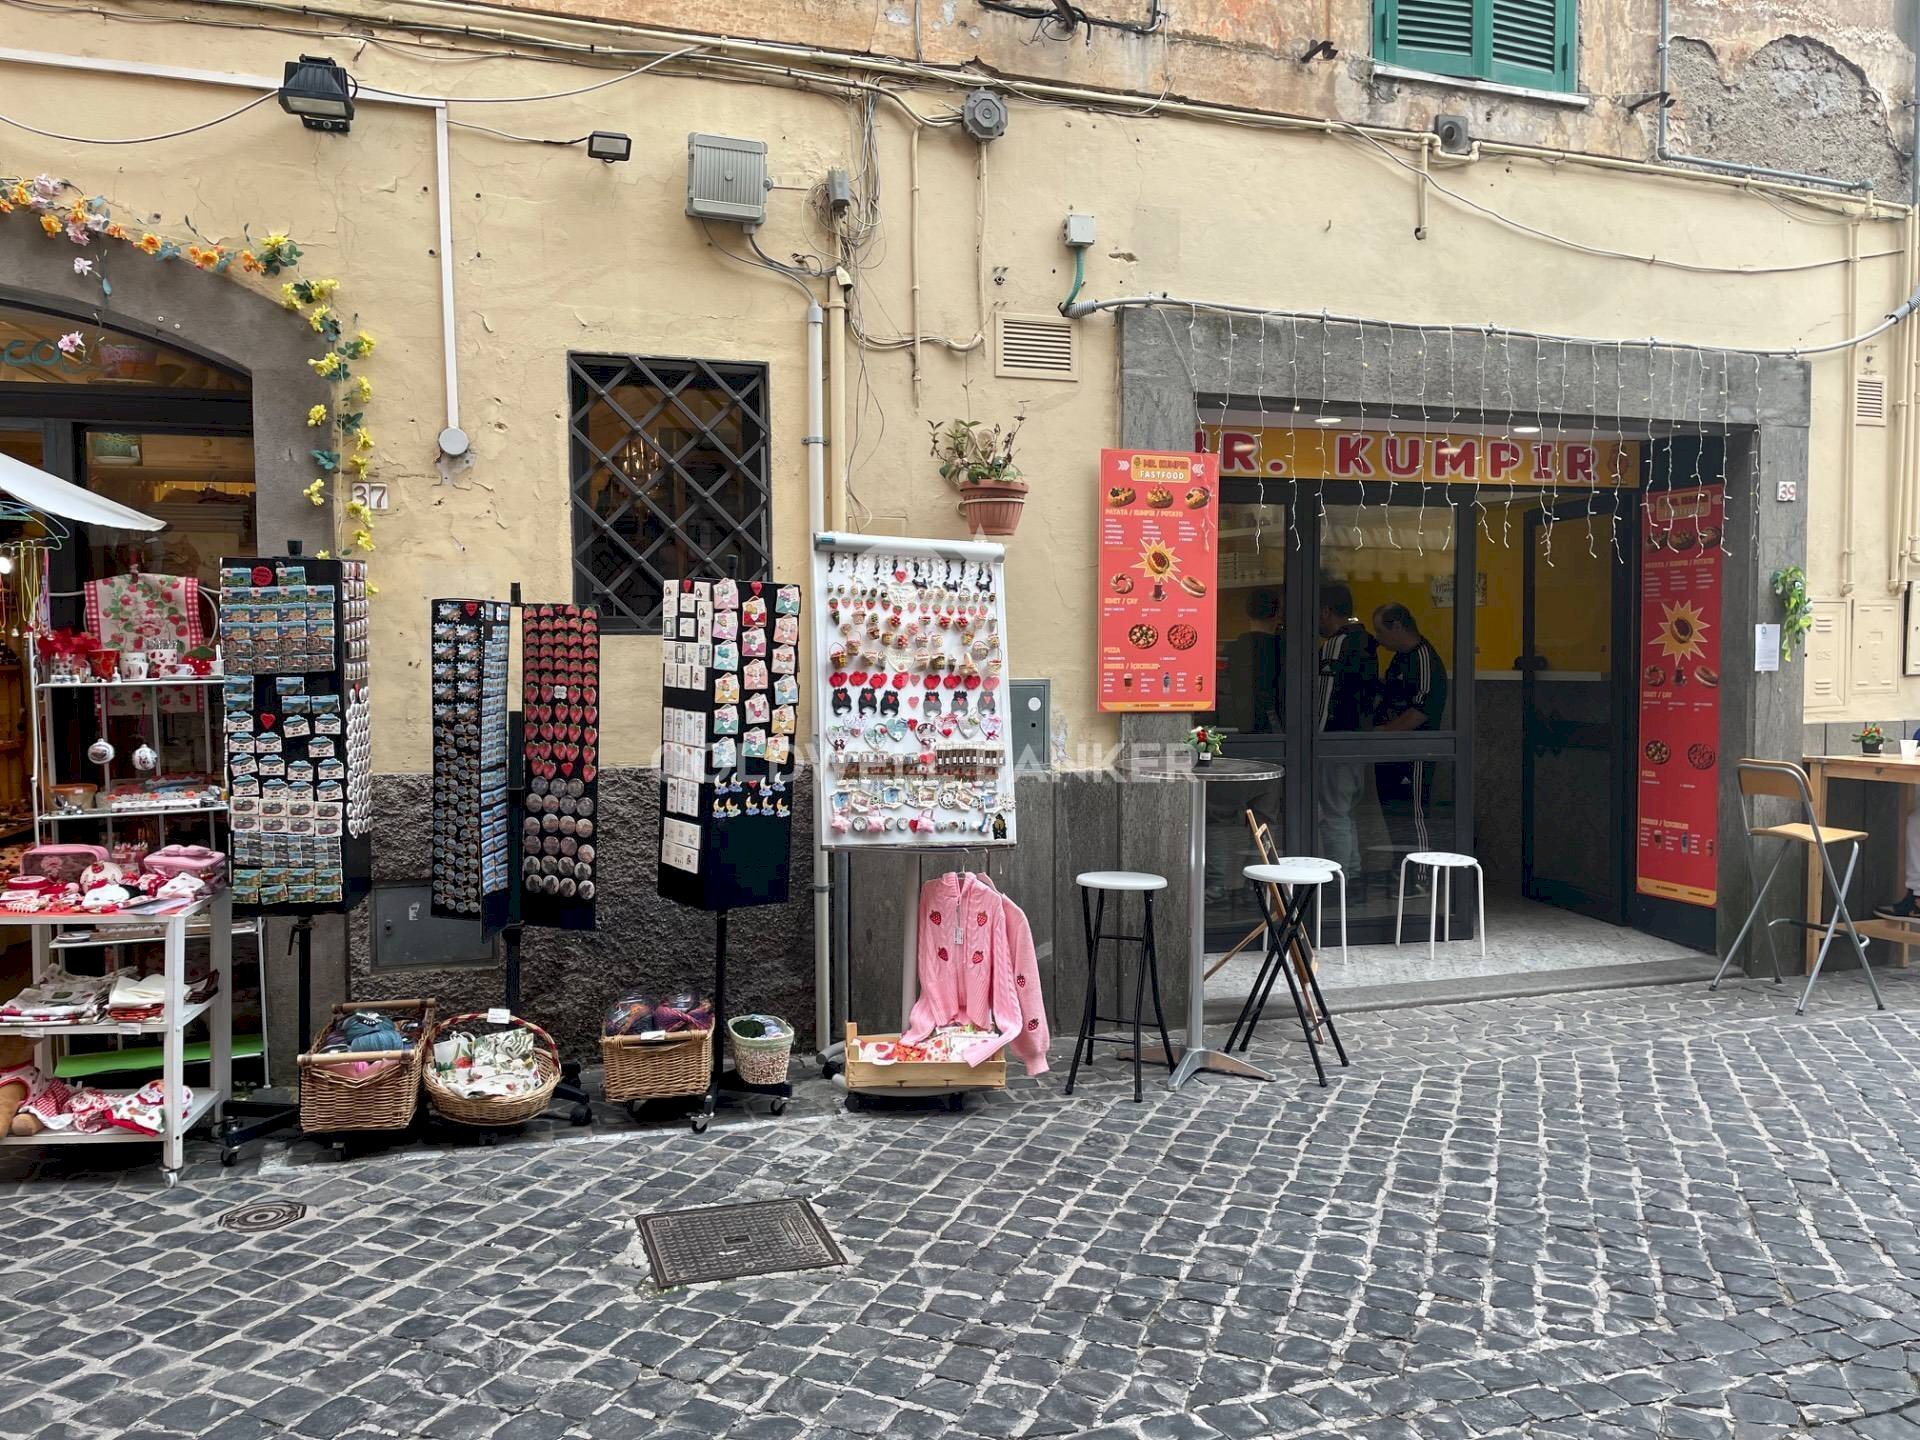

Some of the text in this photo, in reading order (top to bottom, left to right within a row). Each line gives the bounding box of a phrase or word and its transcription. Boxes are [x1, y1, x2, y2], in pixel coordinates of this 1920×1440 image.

[1194, 430, 1600, 482] R. KUMPIR
[1140, 470, 1185, 480] FASTFOOD
[353, 485, 387, 508] 37
[1780, 484, 1796, 500] 39
